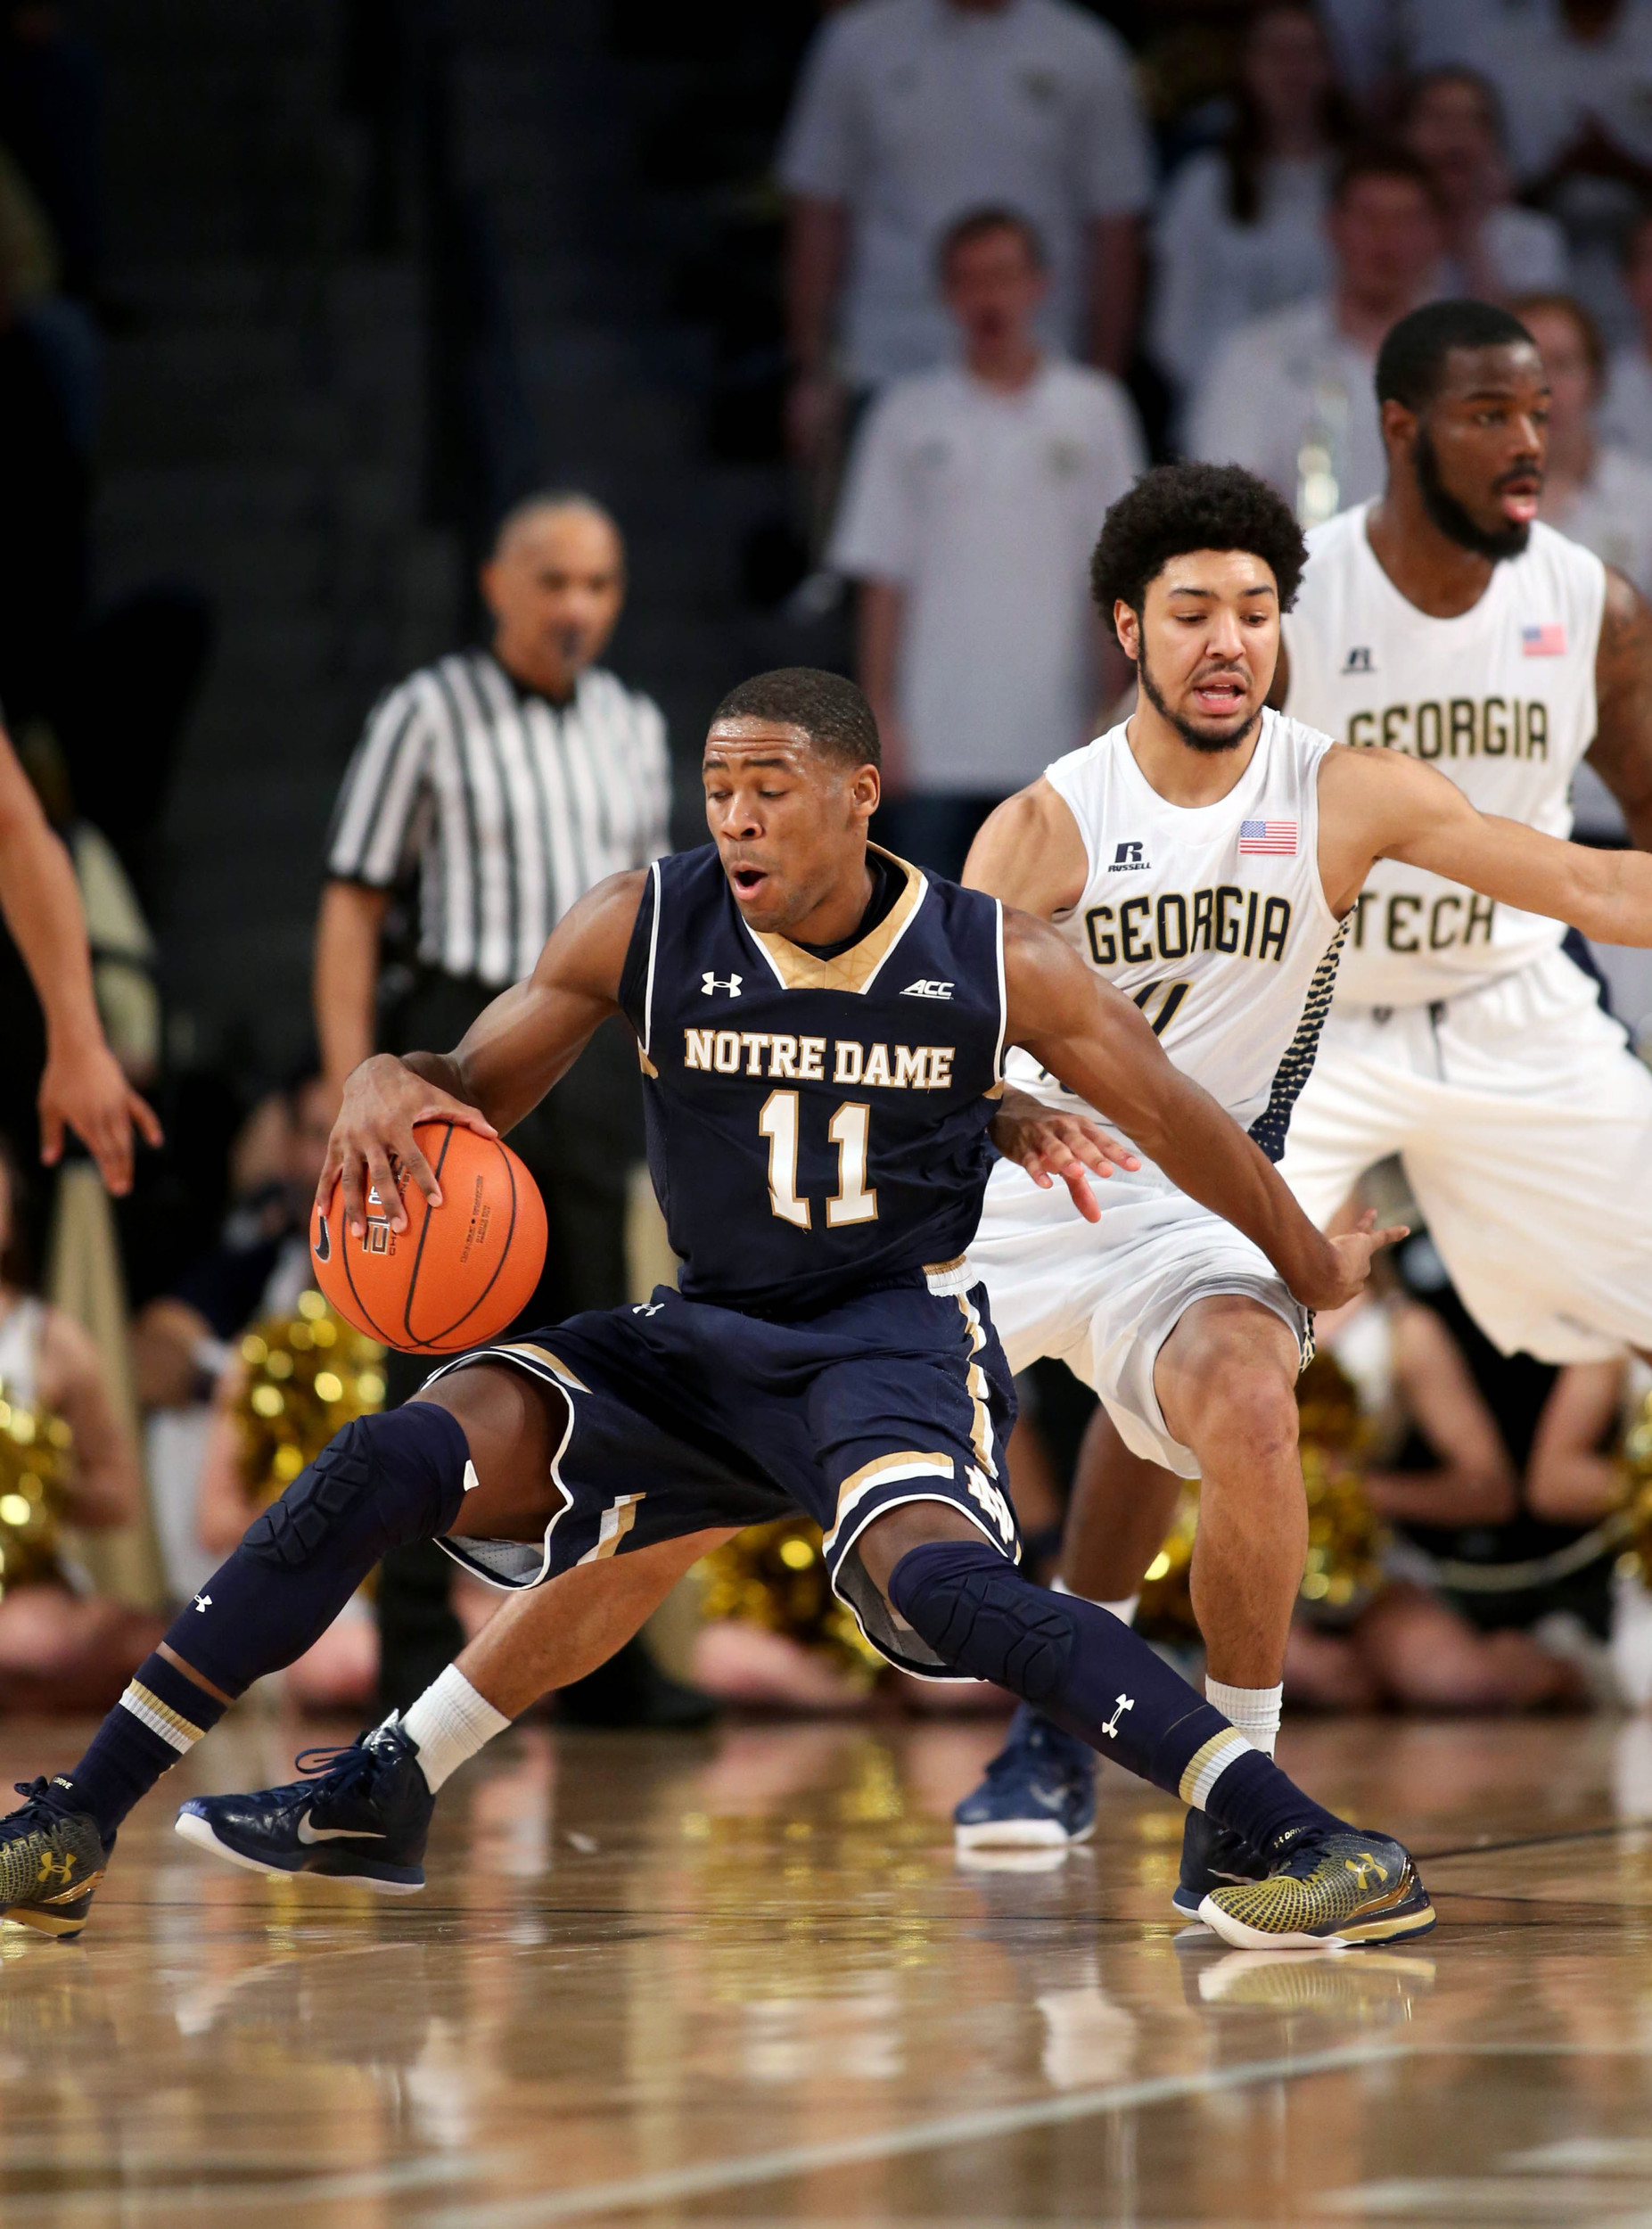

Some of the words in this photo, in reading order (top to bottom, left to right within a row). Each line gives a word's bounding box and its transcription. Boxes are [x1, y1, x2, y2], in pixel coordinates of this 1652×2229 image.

[1107, 862, 1152, 873] RUSSELL
[1084, 885, 1292, 966] GEORGIA
[1352, 891, 1495, 951] TECH
[902, 979, 956, 998] ACC
[684, 1029, 827, 1081] NOTRE
[833, 1040, 956, 1089] DAME
[759, 1089, 879, 1230] 11
